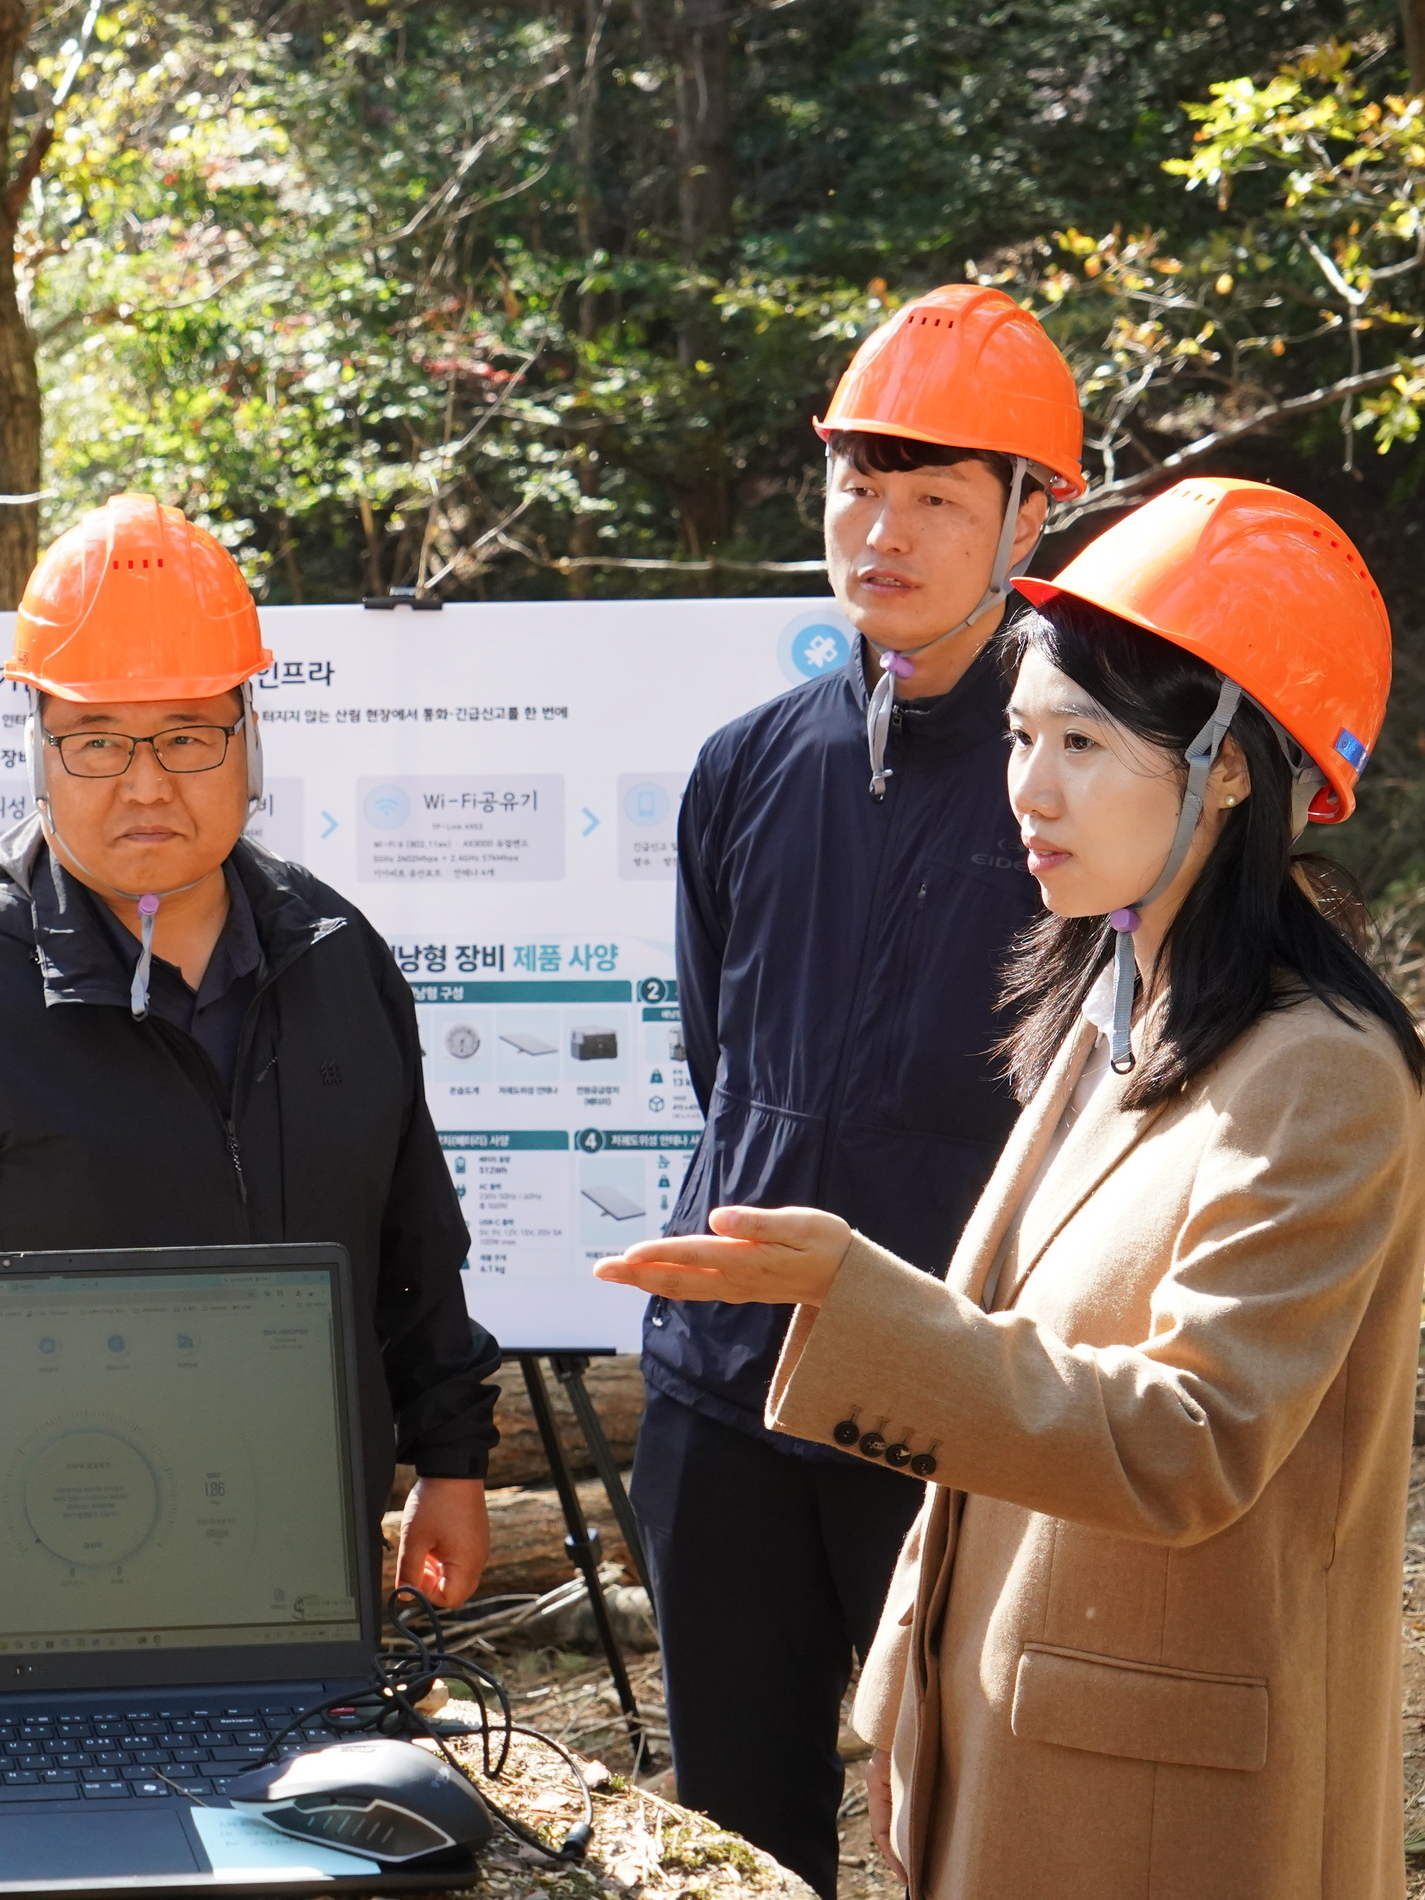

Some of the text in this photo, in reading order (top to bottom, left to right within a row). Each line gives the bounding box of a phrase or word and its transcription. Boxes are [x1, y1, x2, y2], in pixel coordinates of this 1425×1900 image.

[256, 660, 335, 690] 인프라
[262, 709, 301, 724] 터지지
[304, 709, 330, 724] 않는
[335, 708, 362, 724] 산림
[366, 707, 419, 724] 현장에서
[524, 706, 538, 721] 한
[542, 705, 569, 720] 번에
[423, 789, 538, 814] Wi-Fi공유기
[390, 942, 620, 973] 낭형 장비 제품 사양
[439, 985, 465, 1001] 구성
[646, 981, 660, 1000] 2
[489, 1134, 510, 1148] 사양
[584, 1132, 598, 1149] 4
[610, 1133, 659, 1147] 저궤도위성
[659, 1133, 689, 1147] 안테나
[204, 1480, 226, 1498] 1.86
